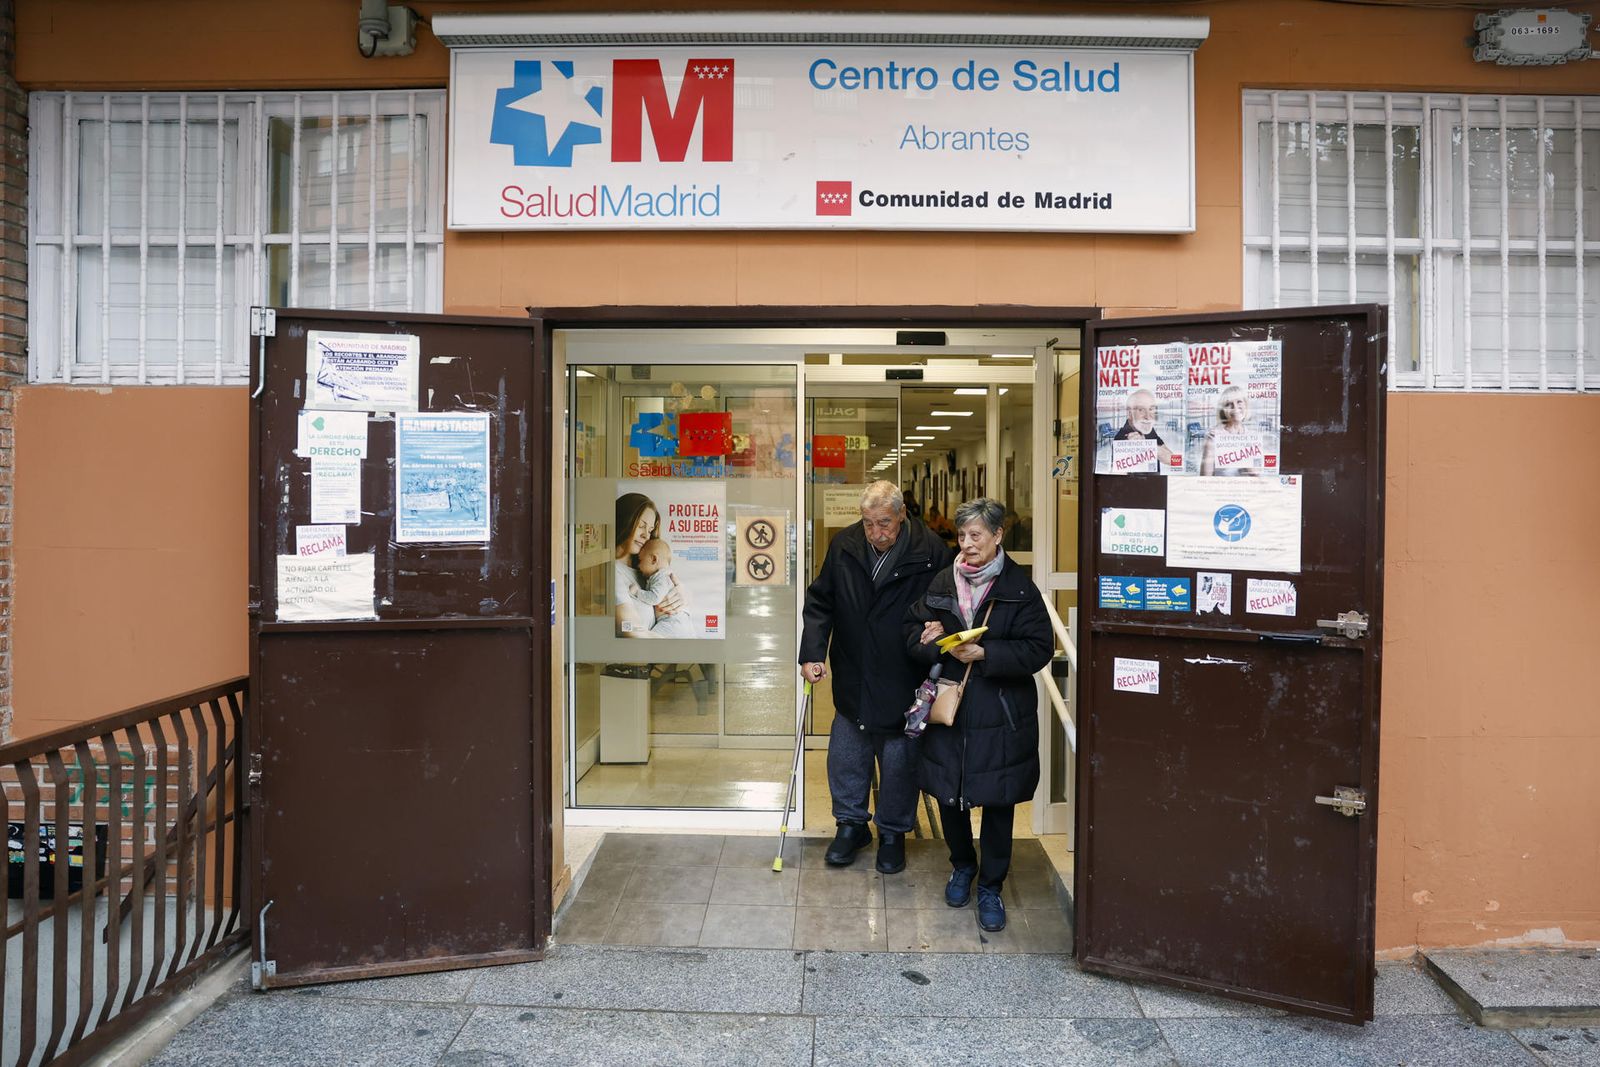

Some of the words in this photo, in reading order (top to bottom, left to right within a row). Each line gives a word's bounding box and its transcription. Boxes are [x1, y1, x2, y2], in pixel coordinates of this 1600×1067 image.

[808, 58, 939, 91] Centro
[951, 60, 1000, 91] de
[1012, 60, 1120, 93] Salud
[899, 124, 1030, 152] Abrantes
[500, 184, 720, 218] SaludMadrid
[858, 190, 989, 208] Comunidad
[998, 191, 1025, 209] de
[1035, 192, 1112, 210] Madrid
[328, 342, 369, 350] COMUNIDAD
[1100, 368, 1140, 388] NATE
[1188, 366, 1231, 386] NATE
[309, 447, 361, 456] DERECHO
[1115, 450, 1156, 470] RECLAMA
[1217, 445, 1262, 466] RECLAMA
[669, 504, 719, 517] PROTEJA
[669, 520, 676, 532] A
[678, 520, 691, 532] SU
[694, 517, 719, 532] BEBÉ
[300, 536, 344, 557] RECLAMA
[1111, 544, 1159, 554] DERECHO
[1249, 593, 1294, 610] RECLAMA
[1117, 671, 1157, 688] RECLAMA
